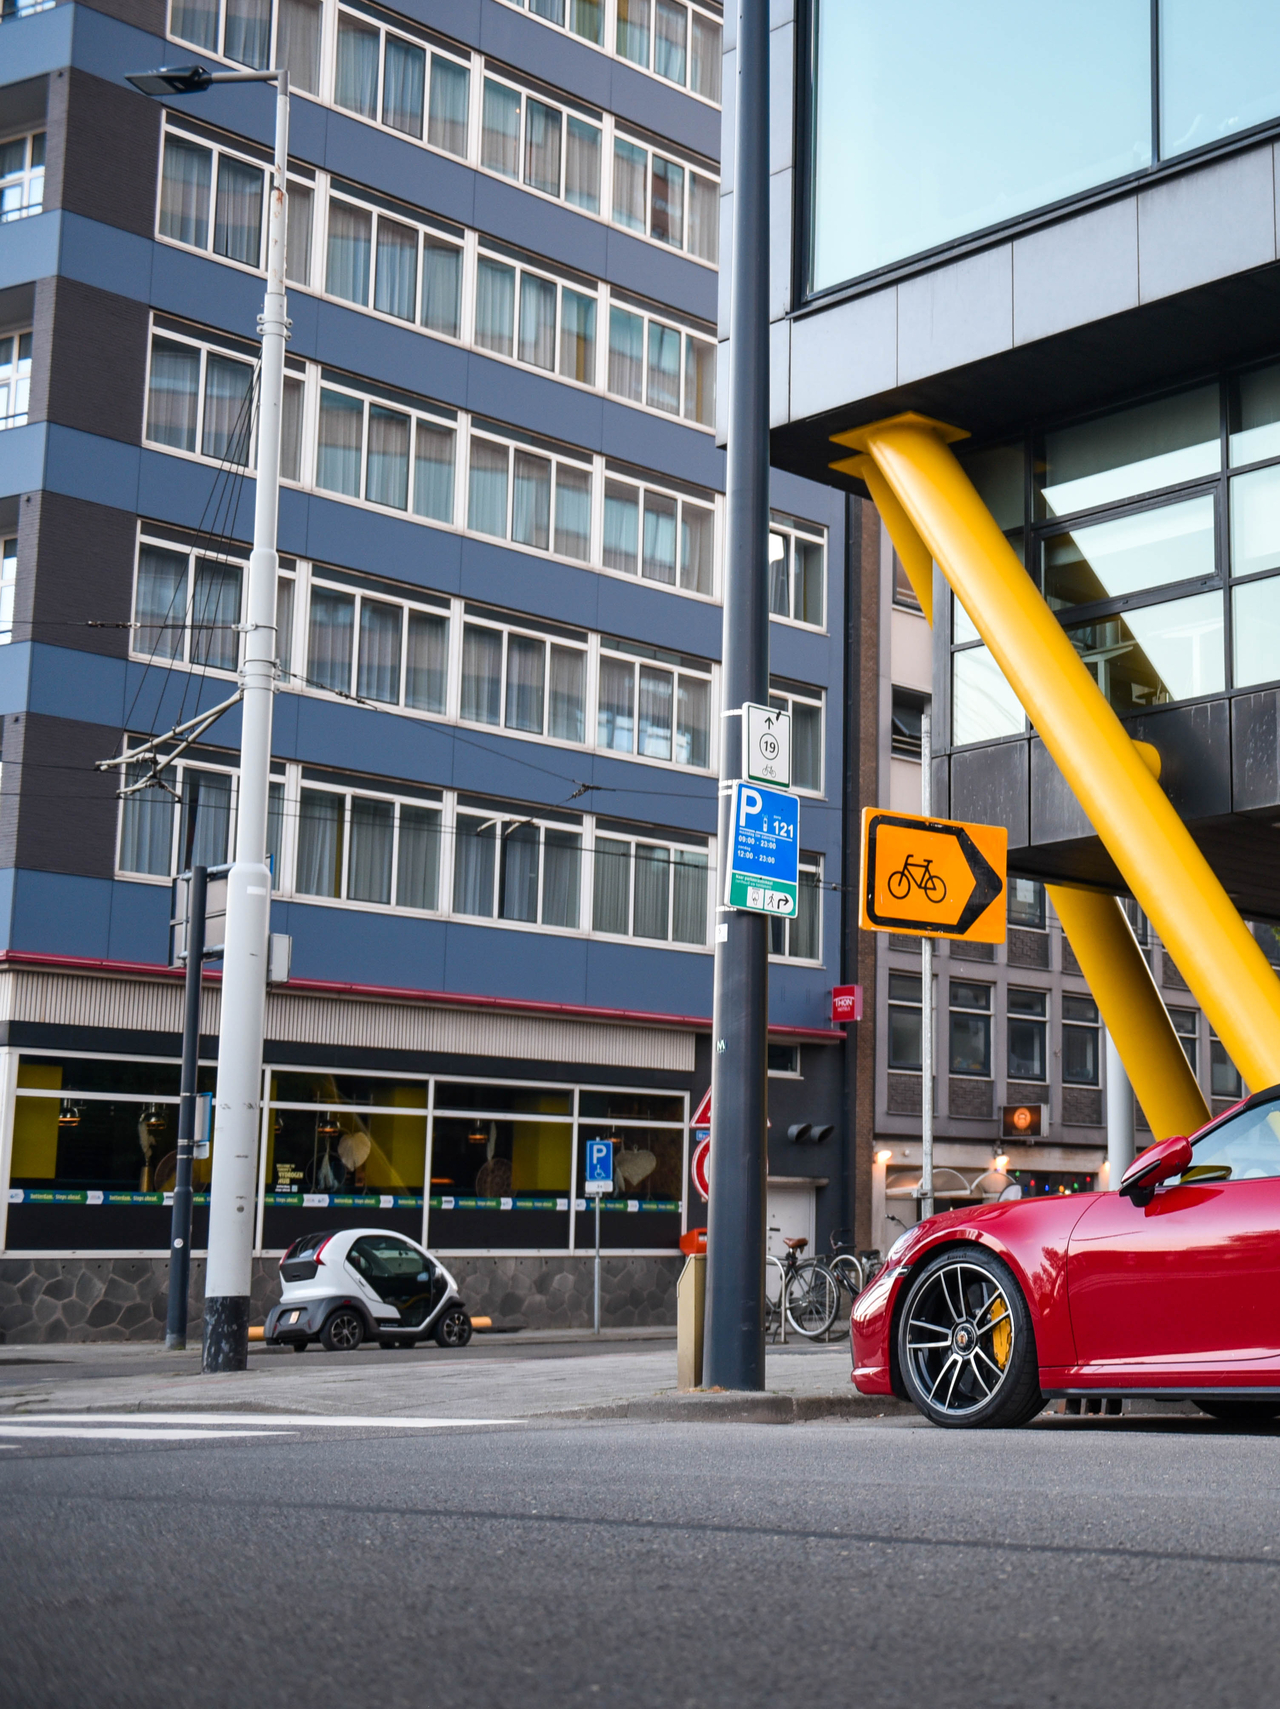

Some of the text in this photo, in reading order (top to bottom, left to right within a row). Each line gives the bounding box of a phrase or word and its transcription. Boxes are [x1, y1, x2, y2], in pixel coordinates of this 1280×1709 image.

[763, 740, 776, 754] 19
[739, 787, 763, 827] P
[773, 820, 794, 839] 121
[738, 835, 755, 845] 09:00
[760, 840, 777, 850] 23:00
[737, 850, 754, 860] 12:00
[759, 855, 776, 864] 23:00
[833, 995, 855, 1007] THON
[592, 1144, 607, 1165] P
